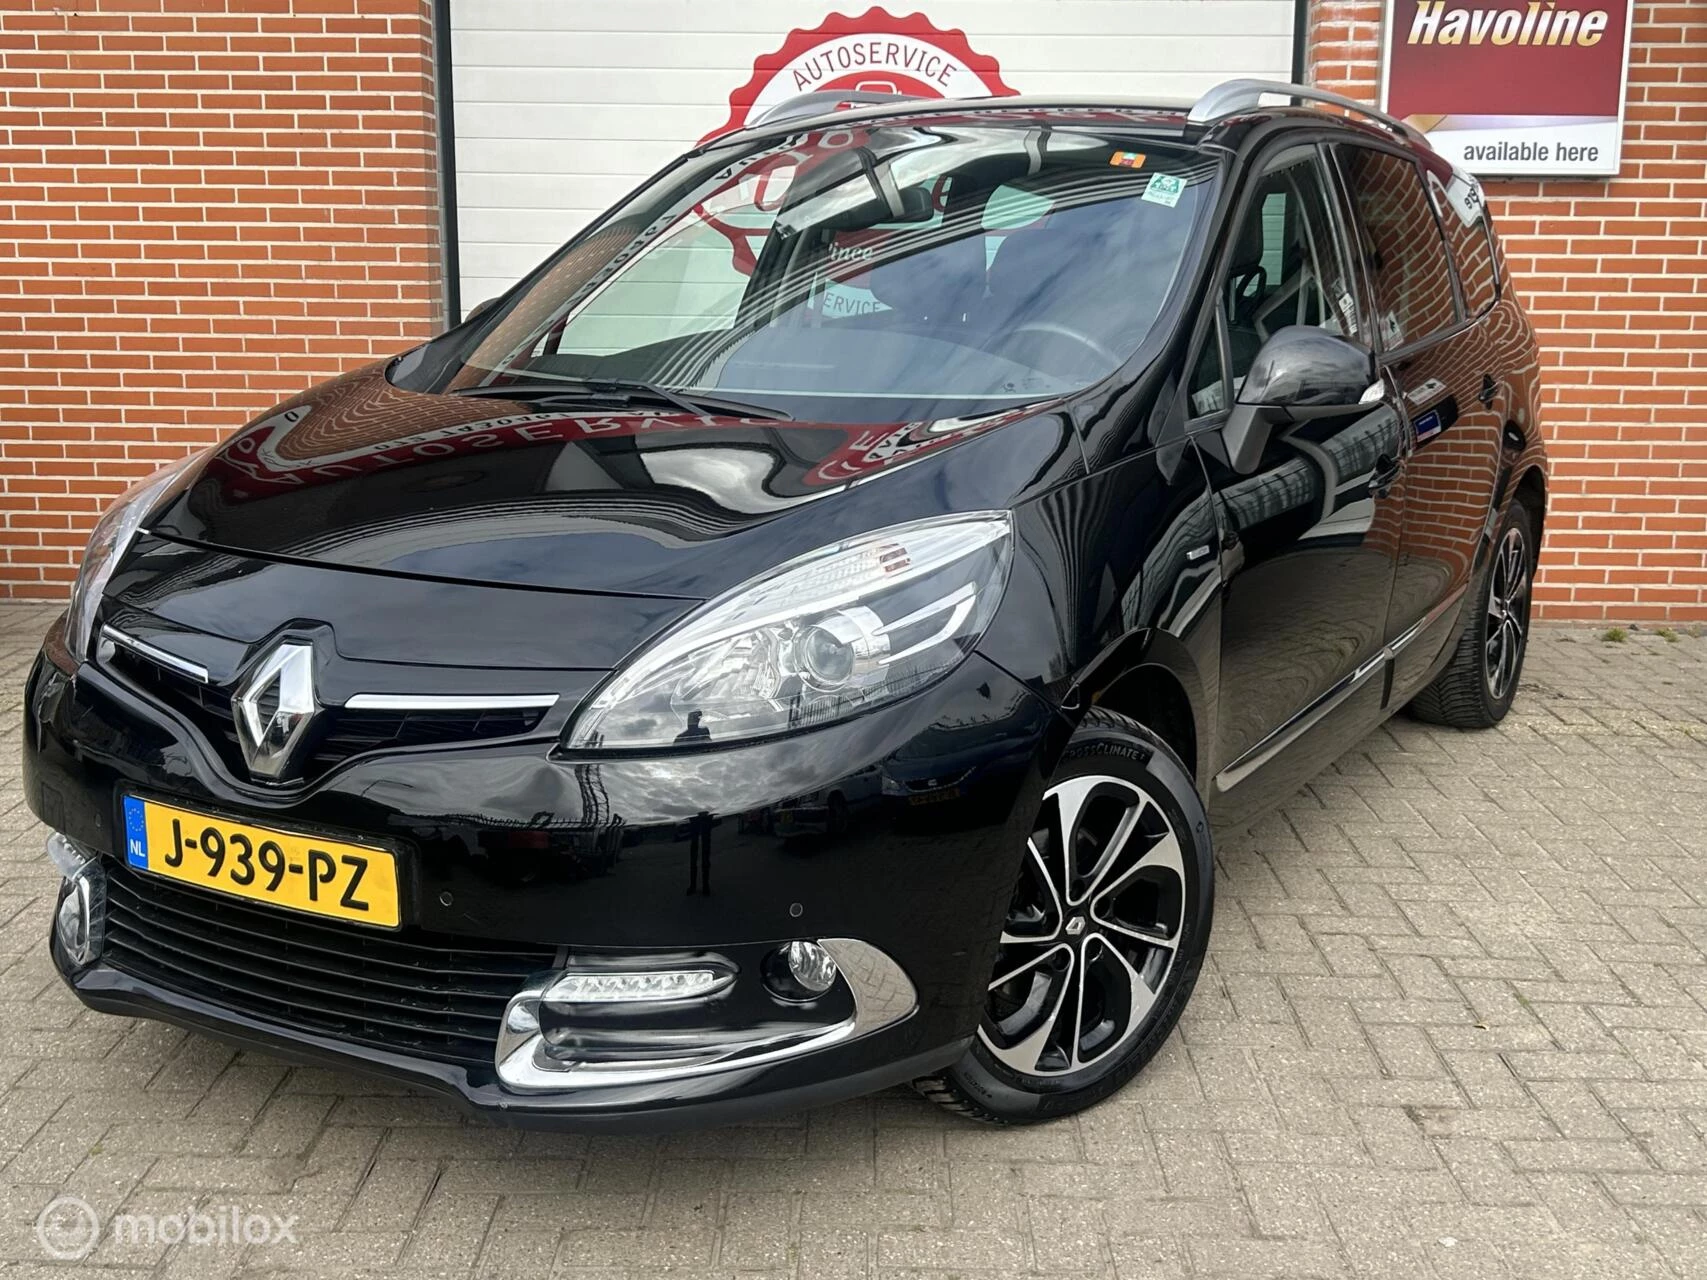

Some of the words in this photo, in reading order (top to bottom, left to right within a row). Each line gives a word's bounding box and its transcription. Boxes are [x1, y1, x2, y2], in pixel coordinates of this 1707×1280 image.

[1407, 1, 1608, 46] Havoline
[793, 42, 957, 91] AUTOSERVICE
[1463, 141, 1549, 161] available
[1556, 142, 1599, 161] here
[824, 292, 882, 314] ERVICE
[129, 838, 146, 857] NL
[164, 818, 369, 911] J-939-PZ
